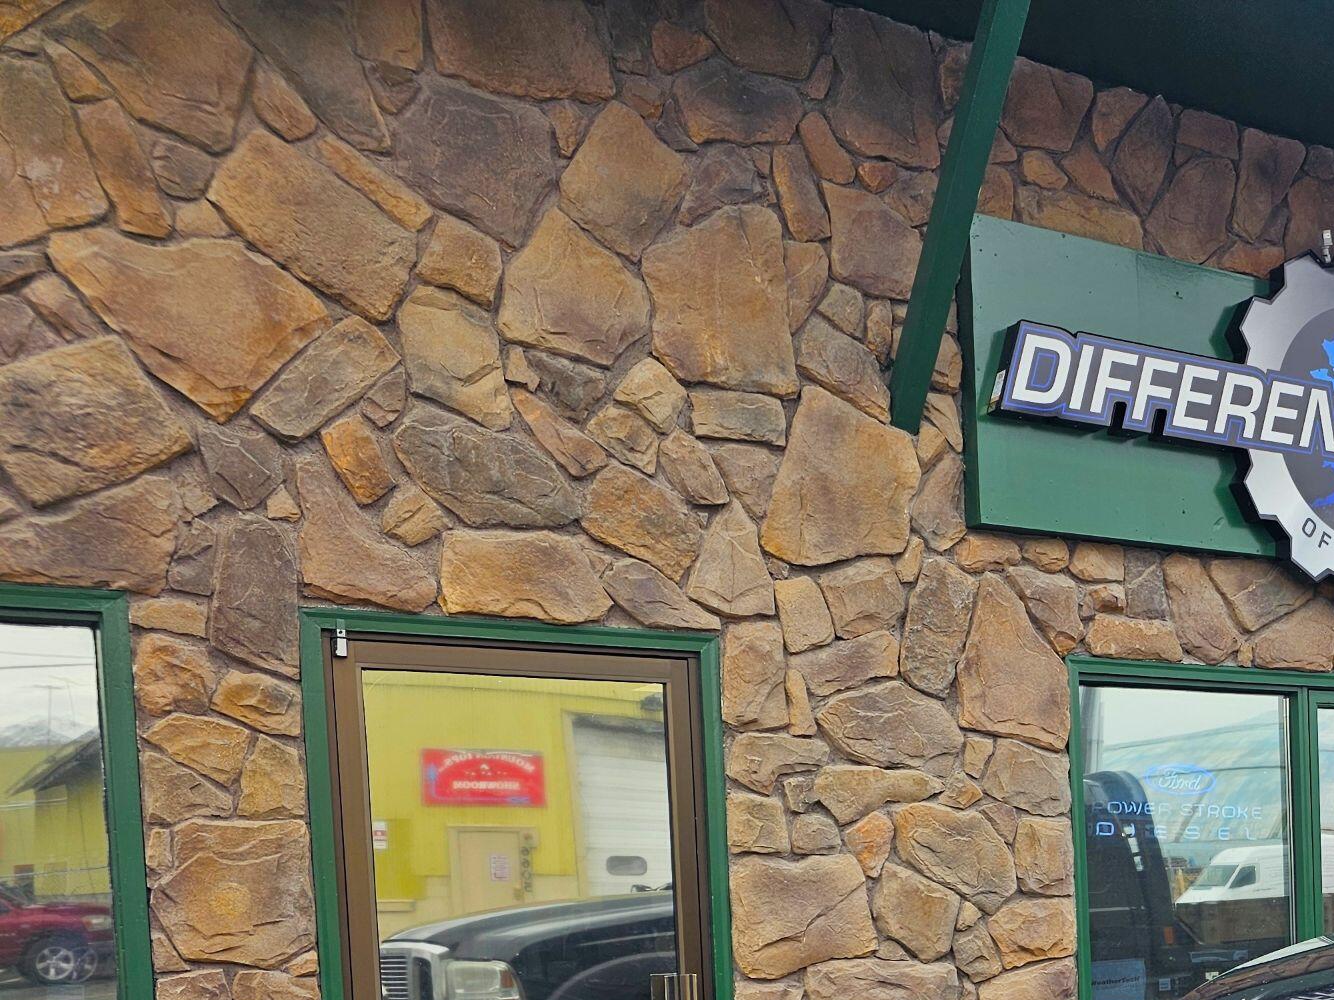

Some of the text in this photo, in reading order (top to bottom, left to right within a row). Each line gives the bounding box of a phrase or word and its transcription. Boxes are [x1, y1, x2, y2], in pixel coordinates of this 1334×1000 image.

[1301, 517, 1332, 549] OF
[1158, 767, 1202, 790] Ford
[1091, 801, 1263, 820] POWER STROKE
